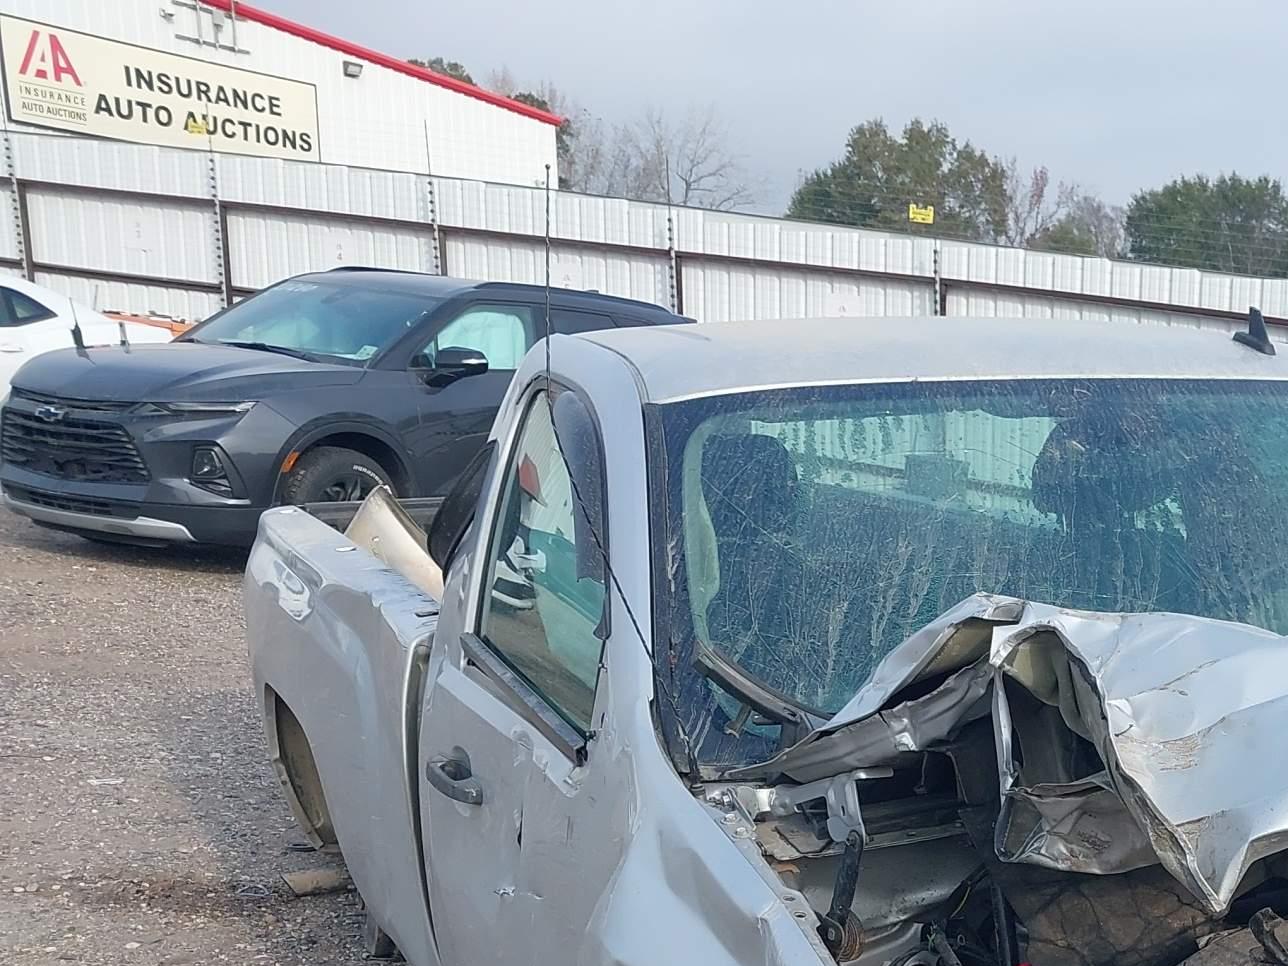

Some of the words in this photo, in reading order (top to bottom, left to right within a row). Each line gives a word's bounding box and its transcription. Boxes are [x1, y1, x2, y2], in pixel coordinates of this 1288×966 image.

[19, 85, 86, 106] INSURANCE
[123, 65, 282, 116] INSURANCE
[22, 101, 45, 114] AUTO
[46, 106, 87, 121] AUCTIONS
[94, 93, 172, 127] AUTO
[184, 111, 312, 152] AUCTIONS
